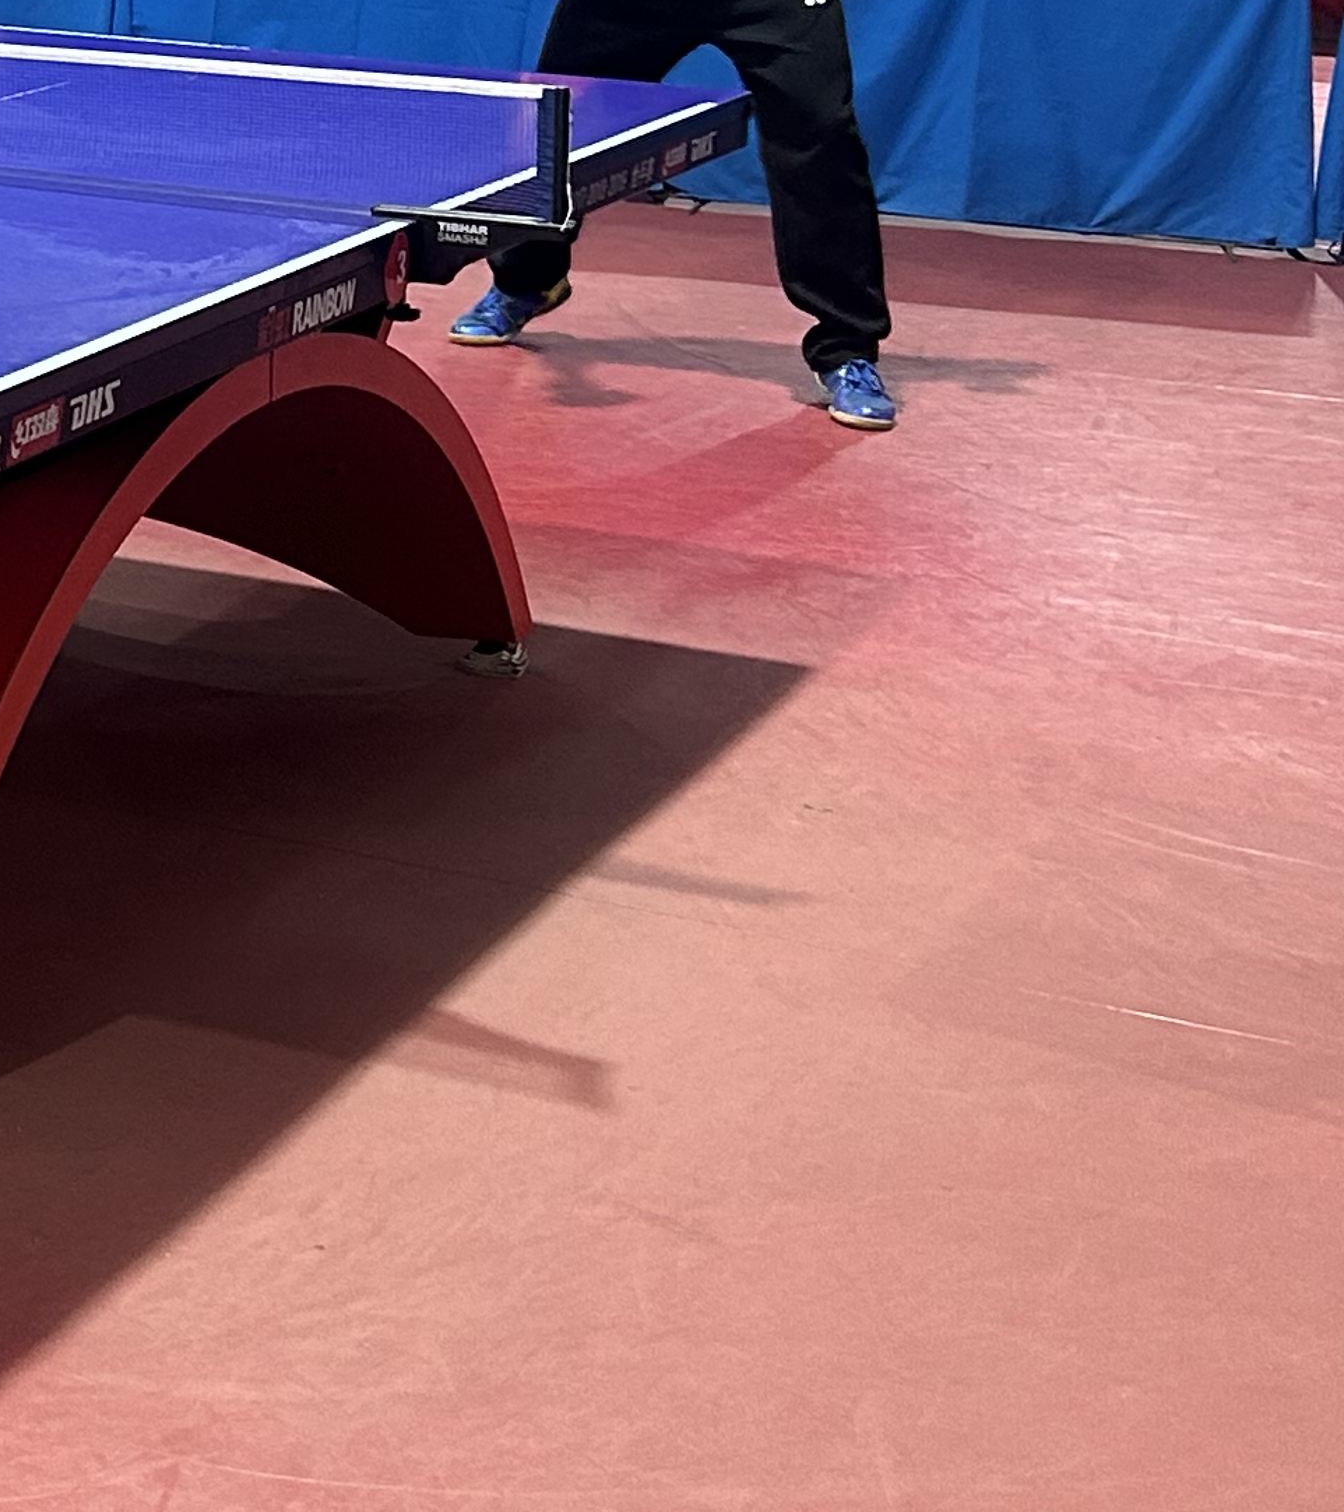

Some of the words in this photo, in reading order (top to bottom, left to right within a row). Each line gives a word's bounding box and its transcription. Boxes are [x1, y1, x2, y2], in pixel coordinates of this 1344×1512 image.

[437, 220, 489, 236] TIBHAR
[291, 277, 357, 337] RAINBOW
[69, 378, 122, 432] DHS
